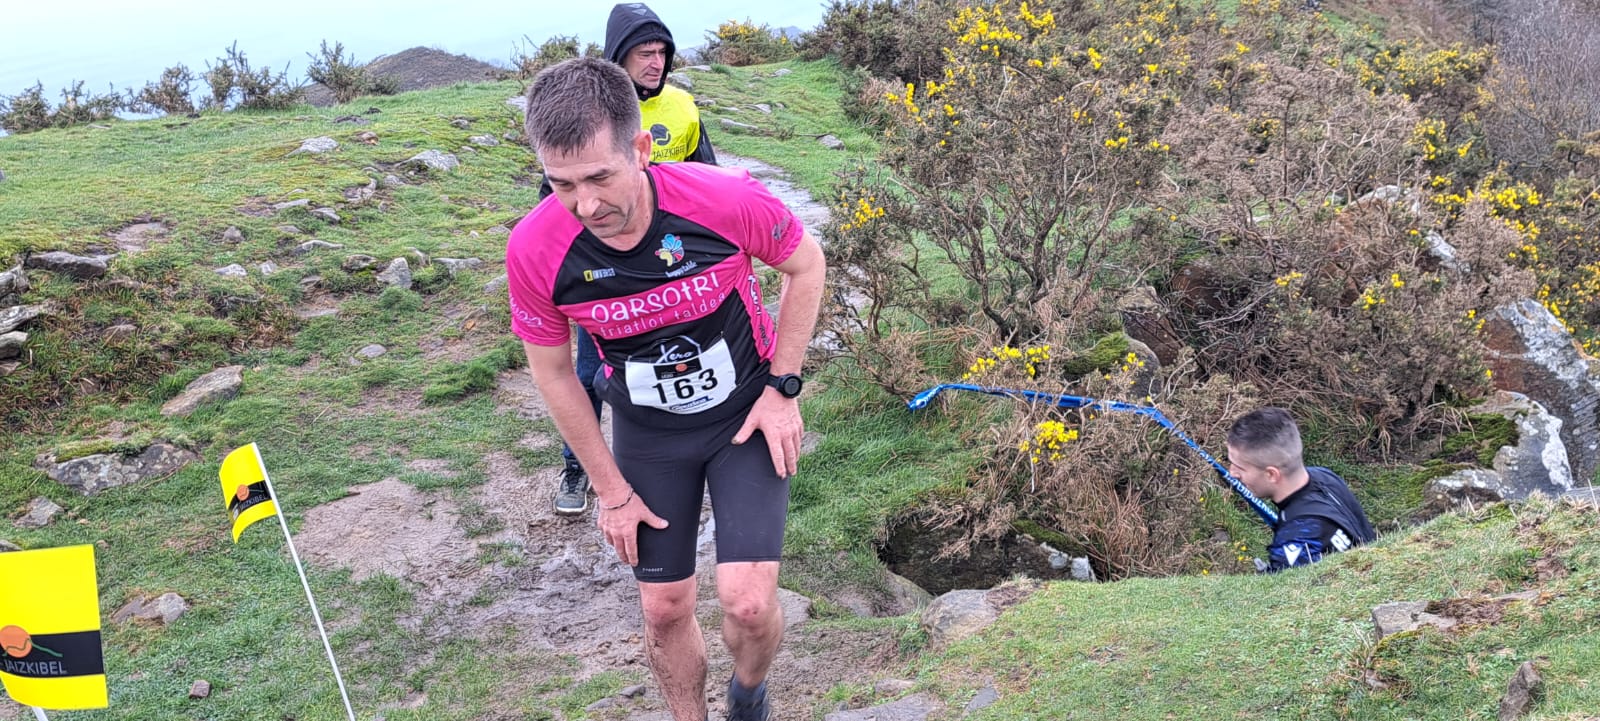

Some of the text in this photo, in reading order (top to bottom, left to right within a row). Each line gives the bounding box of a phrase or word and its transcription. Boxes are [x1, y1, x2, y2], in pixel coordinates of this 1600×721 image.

[600, 314, 664, 337] triatloi
[674, 293, 726, 320] taldea
[653, 368, 718, 404] 163
[4, 660, 67, 674] JAIZKIBEL
